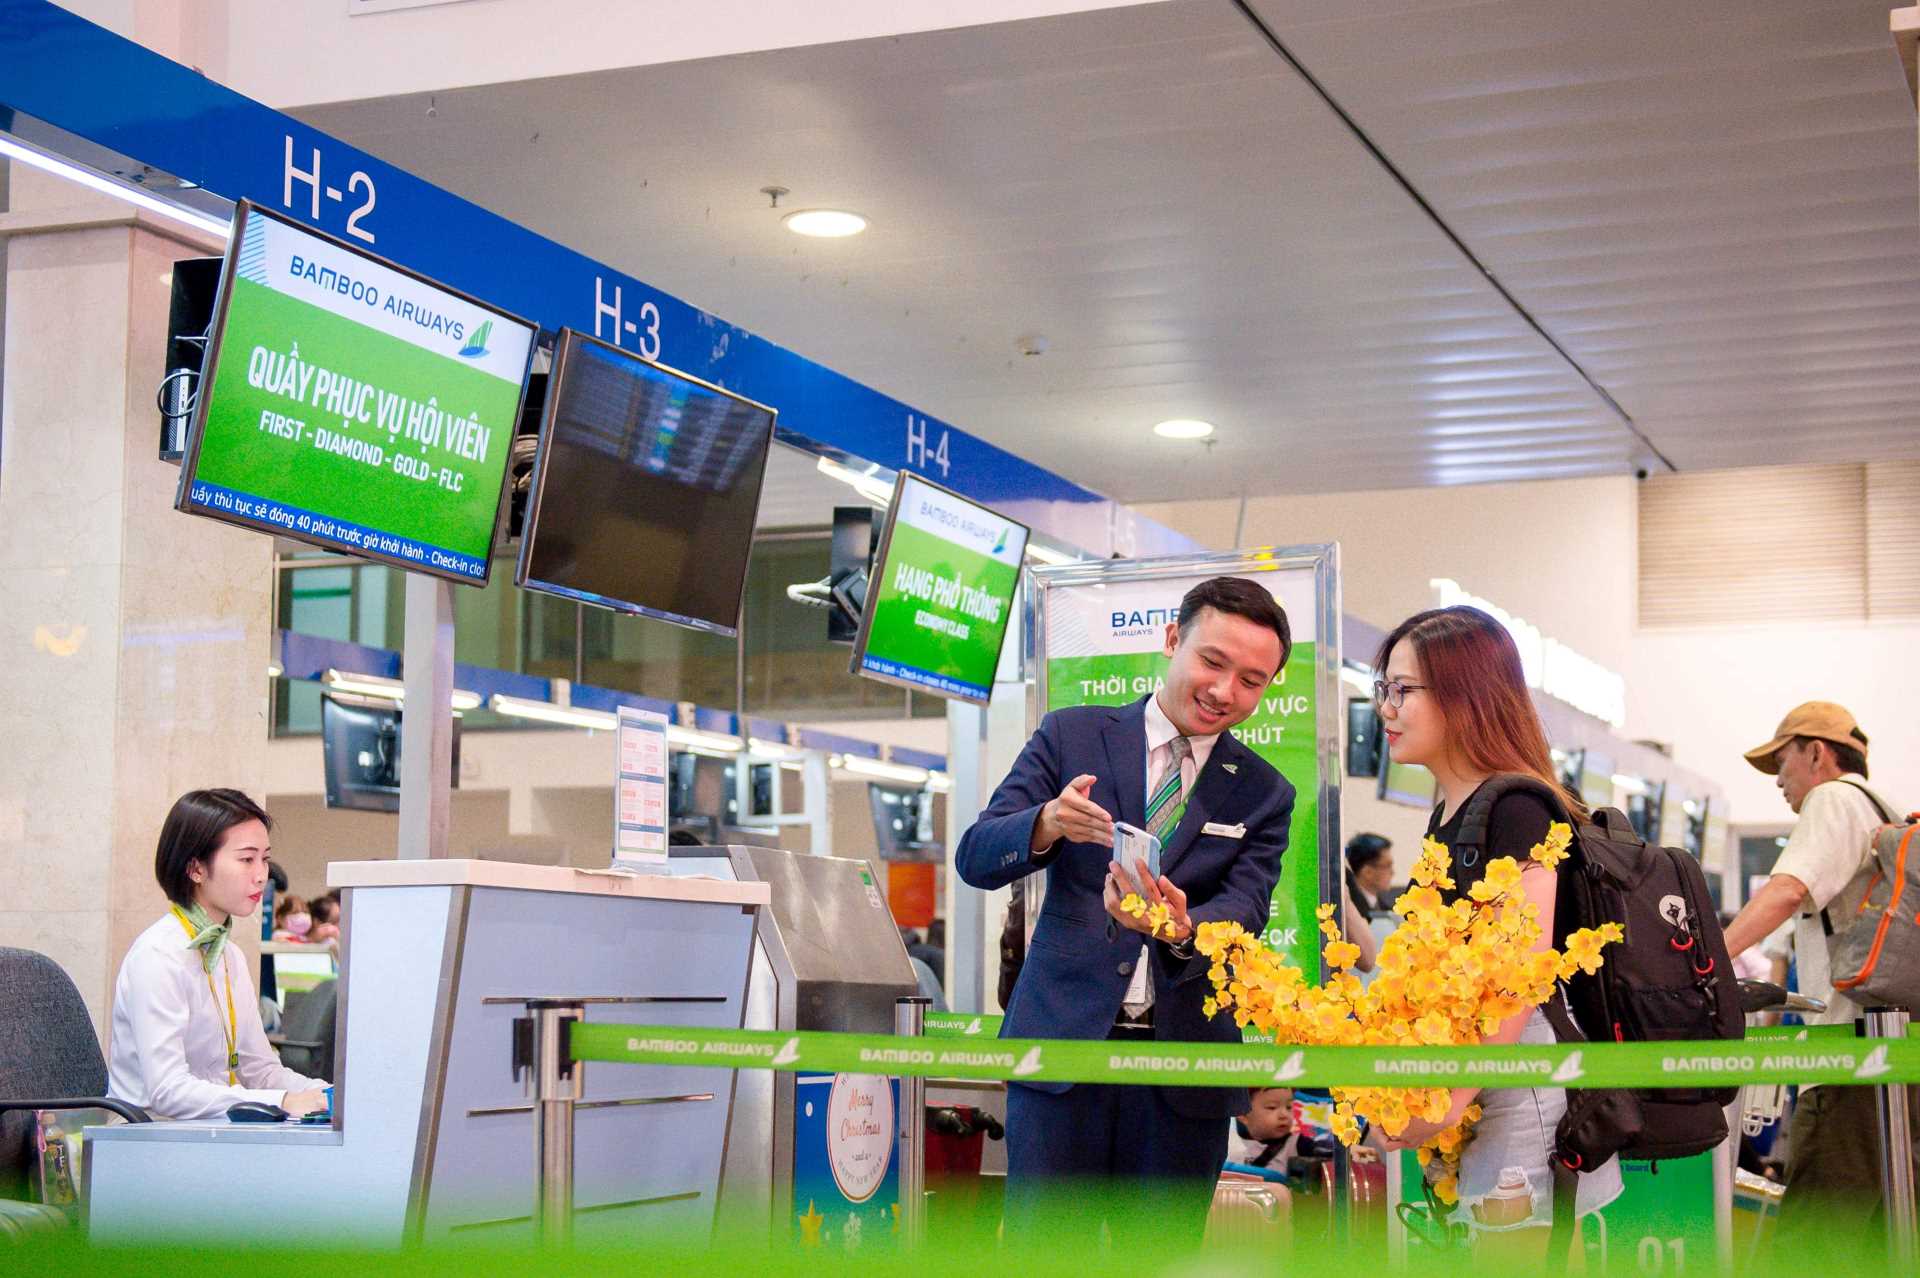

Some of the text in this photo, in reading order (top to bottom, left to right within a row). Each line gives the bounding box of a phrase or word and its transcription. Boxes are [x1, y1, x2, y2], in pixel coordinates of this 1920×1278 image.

[284, 135, 375, 244] H-2
[290, 255, 464, 341] BAMBOO AIRWAYS
[595, 276, 661, 361] H-3
[248, 341, 491, 463] QUẦY PHỤC VỤ HỘI VIÊN
[259, 410, 305, 442] FIRST
[314, 428, 383, 467] DIAMOND
[393, 453, 430, 482] GOLD
[439, 467, 464, 492] FLC
[907, 414, 951, 477] H-4
[214, 492, 232, 508] thủ
[235, 498, 252, 515] tục
[254, 504, 267, 518] sẽ
[269, 507, 295, 528] đóng
[297, 515, 310, 530] 40
[311, 520, 336, 536] phút
[336, 525, 363, 544] trước
[363, 533, 379, 549] giờ
[401, 543, 424, 560] hành
[431, 551, 467, 572] Check-in
[894, 562, 934, 602] HẠNG
[960, 585, 1001, 624] THÔNG
[1112, 629, 1153, 638] AIRWAYS
[1080, 674, 1126, 697] THỜI
[1265, 694, 1308, 717] VỰC
[627, 1038, 774, 1058] BAMBOO AIRWAYS
[859, 1049, 1014, 1067] BAMBOO AIRWAYS
[1109, 1055, 1275, 1073] BAMBOO AIRWAYS
[1374, 1058, 1552, 1074] BAMBOO AIRWAYS
[1661, 1054, 1855, 1072] BAMBOO AIRWAYS
[840, 1117, 881, 1141] Christmas
